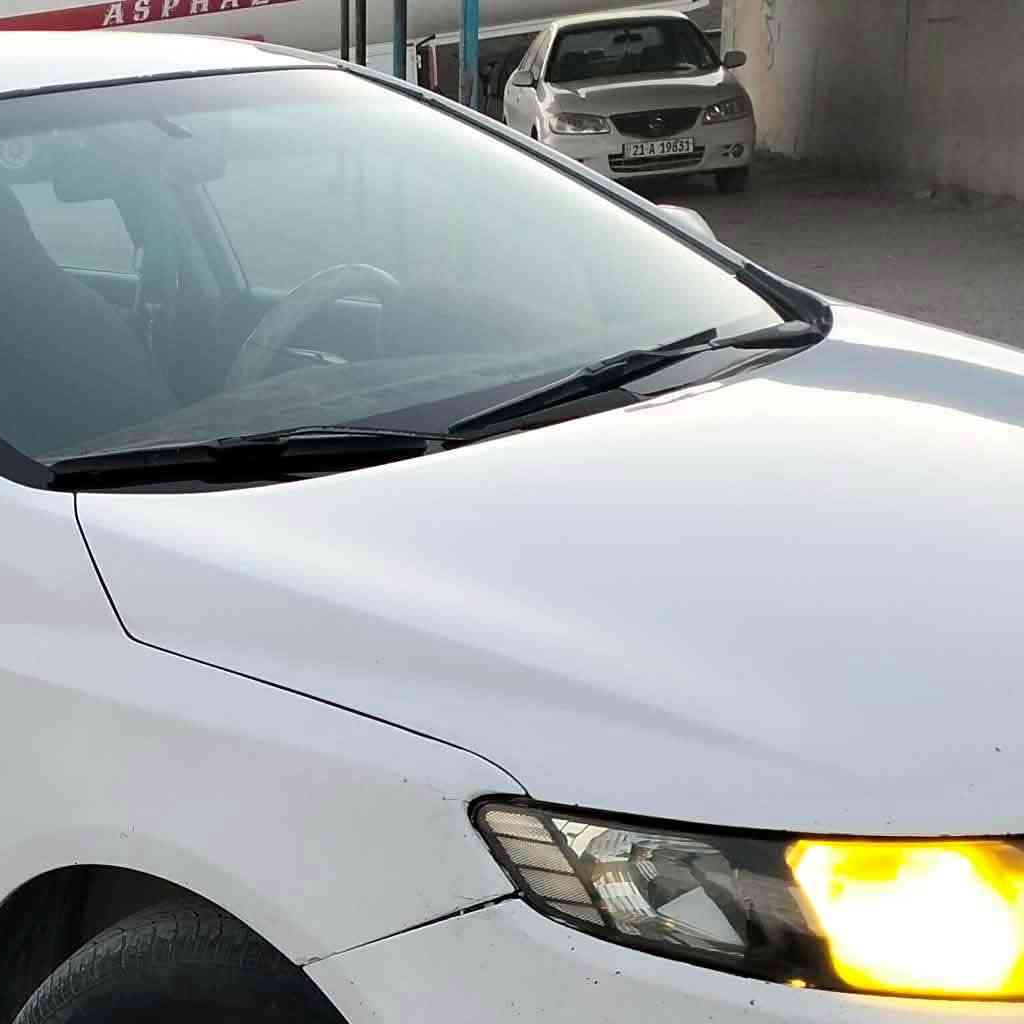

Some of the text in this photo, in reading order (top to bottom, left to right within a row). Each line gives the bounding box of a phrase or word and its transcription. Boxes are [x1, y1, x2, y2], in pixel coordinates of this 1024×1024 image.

[101, 0, 271, 26] ASPH
[632, 143, 645, 156] 21
[648, 143, 656, 155] A
